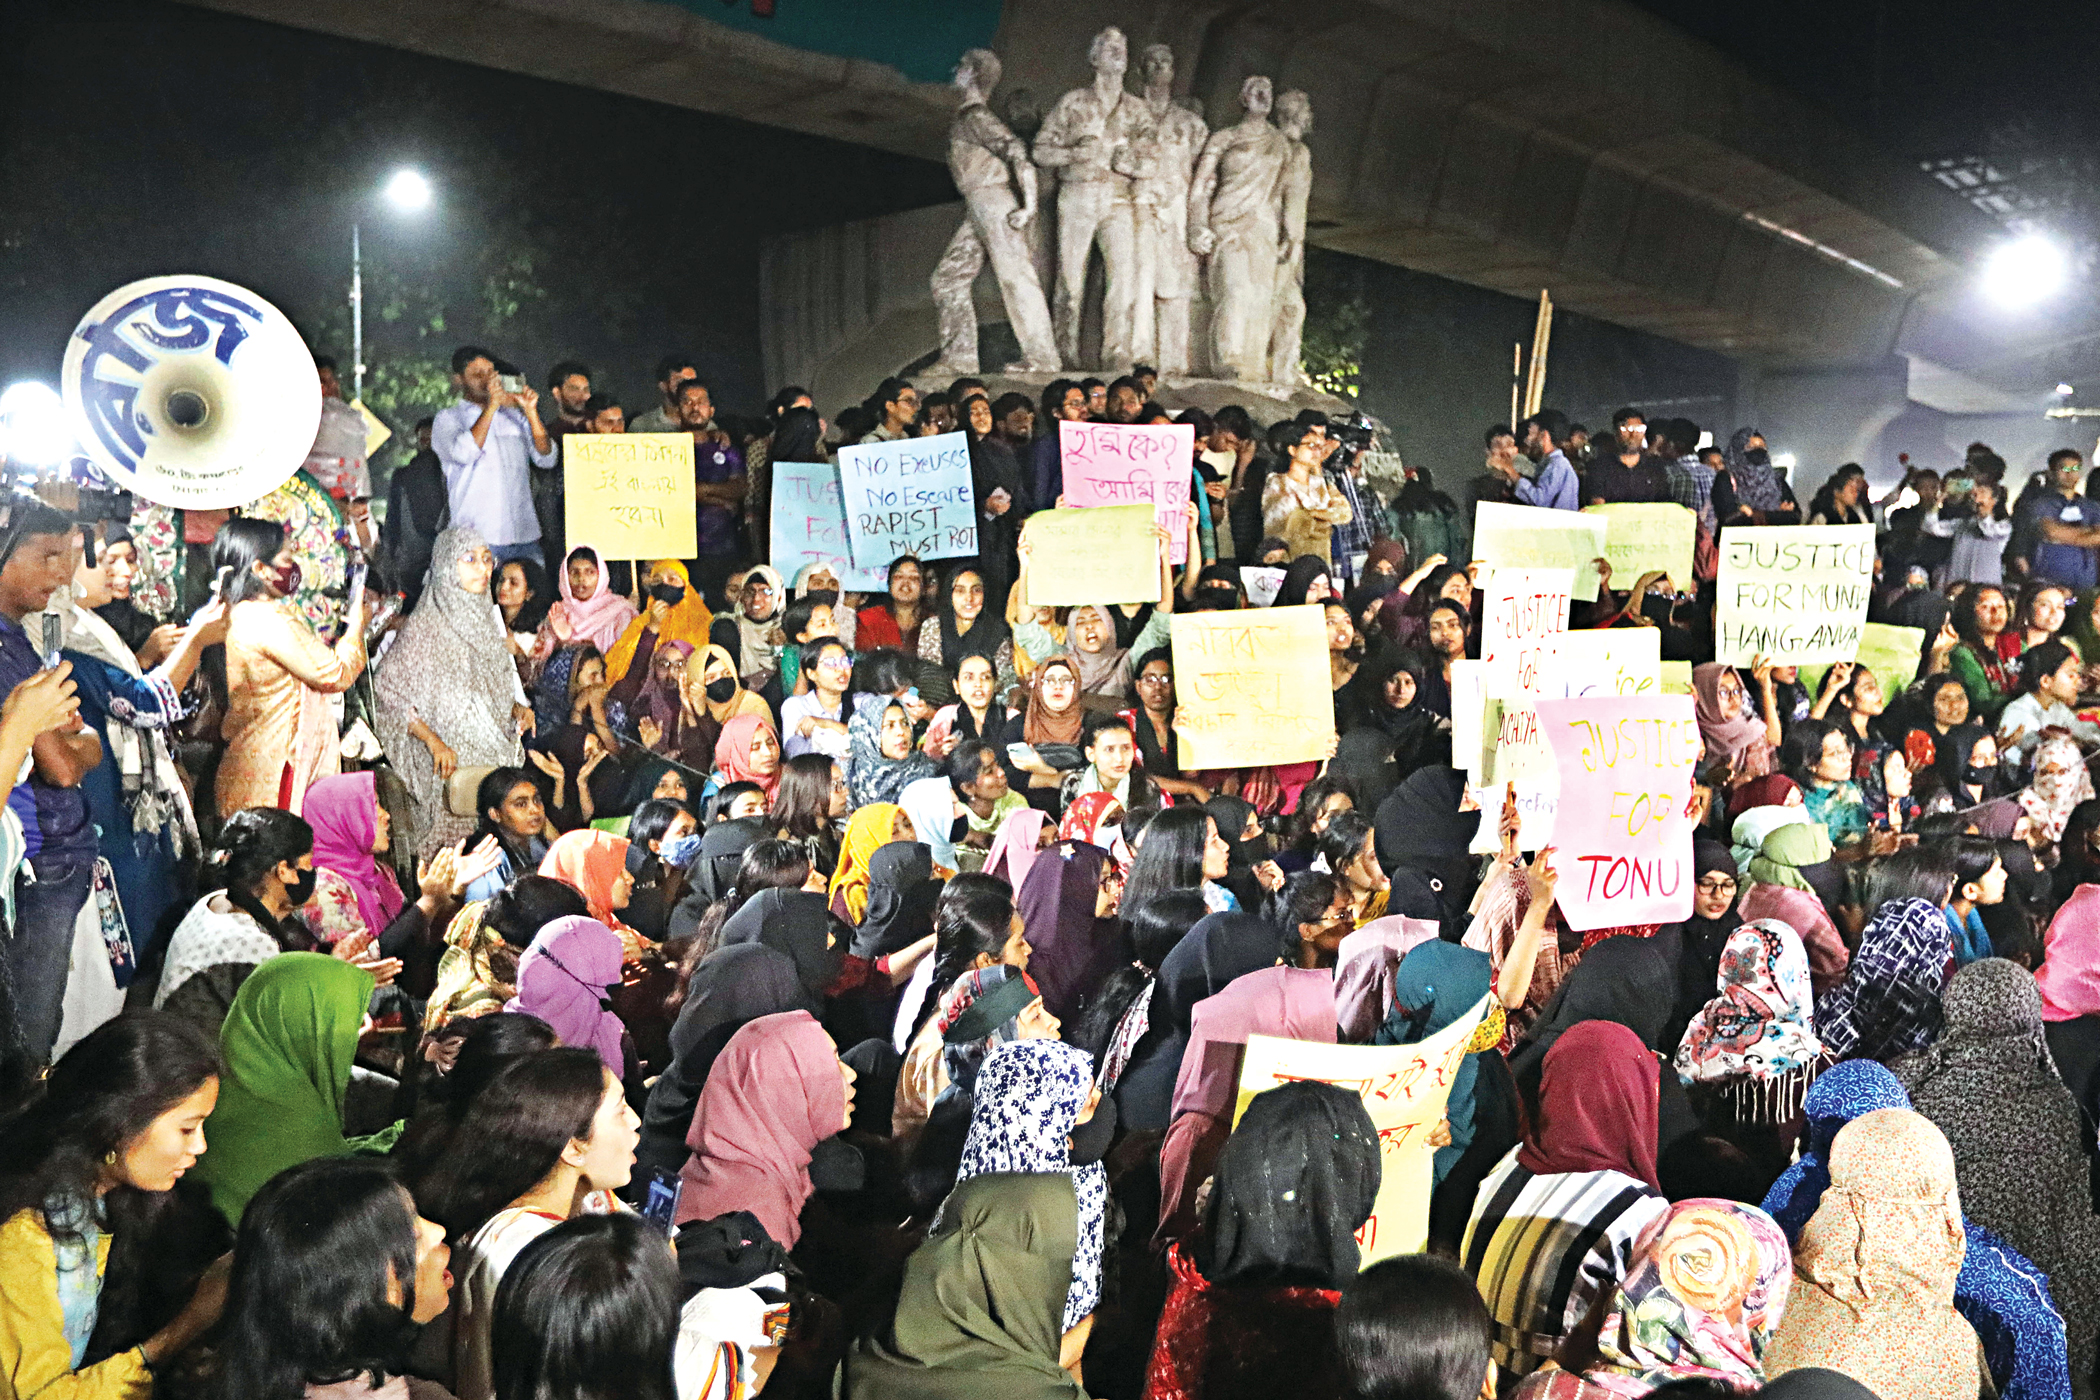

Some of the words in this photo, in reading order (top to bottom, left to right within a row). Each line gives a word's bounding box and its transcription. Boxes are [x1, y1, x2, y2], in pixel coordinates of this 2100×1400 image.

[1064, 426, 1123, 465] তুমি
[1128, 434, 1177, 470] কে?
[1084, 469, 1154, 503] আমি
[857, 506, 943, 535] RAPIST
[890, 534, 940, 555] MUST
[945, 526, 976, 550] ROT
[1729, 542, 1872, 575] JUSTICE
[1502, 593, 1568, 639] JUSTICE
[1737, 582, 1793, 614] FOR
[1724, 622, 1803, 654] HANG
[1496, 710, 1539, 748] ACHIYA
[1569, 718, 1697, 772] JUSTICE
[1606, 791, 1673, 845] FOR
[1577, 855, 1679, 902] TONU
